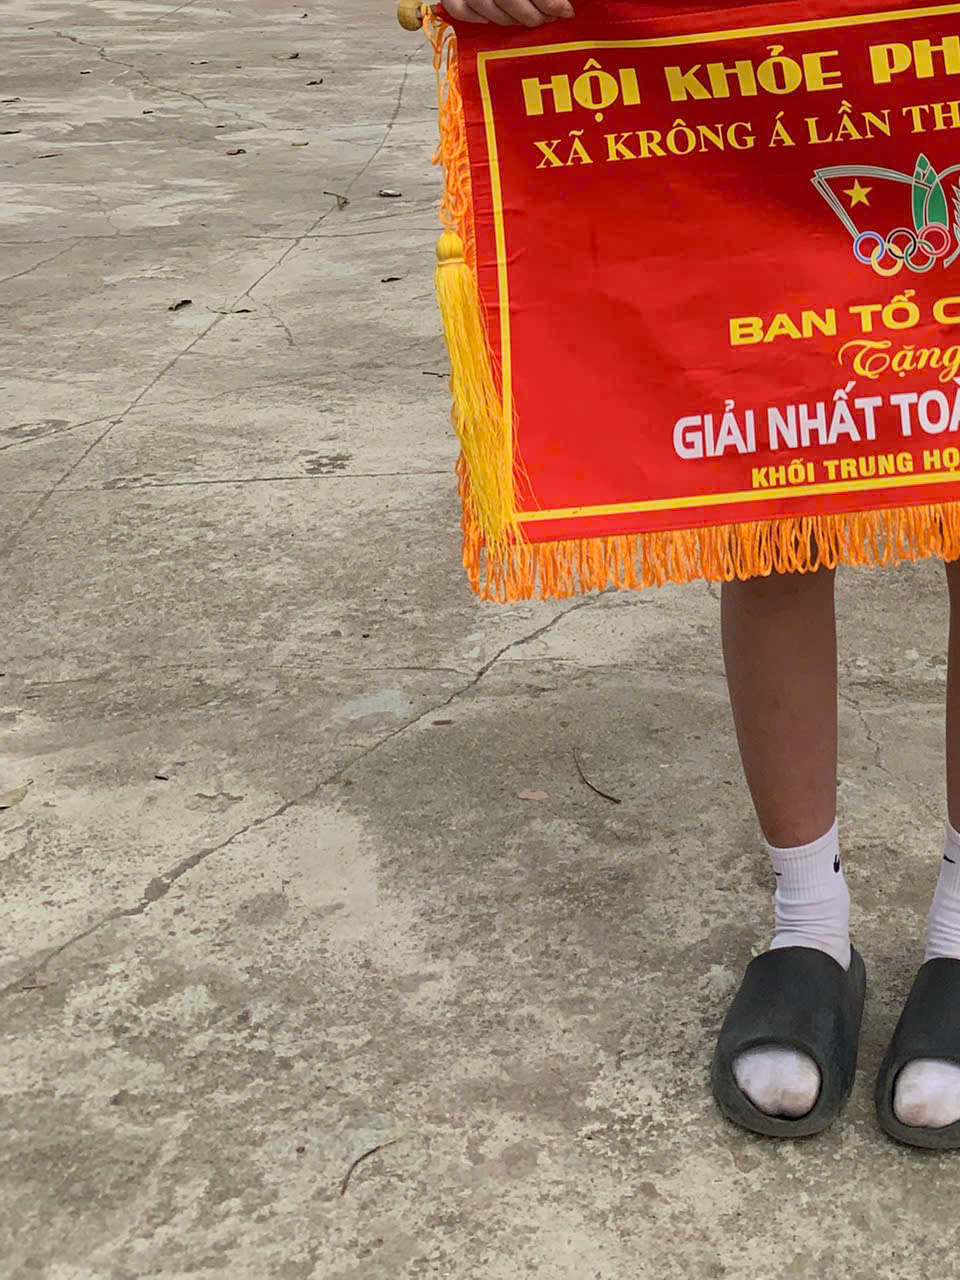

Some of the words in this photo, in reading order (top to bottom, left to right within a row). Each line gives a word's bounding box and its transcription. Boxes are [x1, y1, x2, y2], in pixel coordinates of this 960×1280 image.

[521, 58, 641, 123] HỘI
[664, 45, 843, 102] KHỎE
[533, 129, 593, 169] XÃ
[603, 118, 756, 162] KRÔNG
[768, 111, 796, 147] Á
[804, 100, 892, 145] LẦN
[728, 308, 837, 346] BAN
[849, 288, 921, 333] TỔ
[673, 399, 756, 459] GIẢI
[768, 381, 883, 451] NHẤT
[751, 458, 815, 488] KHỐI
[823, 451, 914, 478] TRUNG
